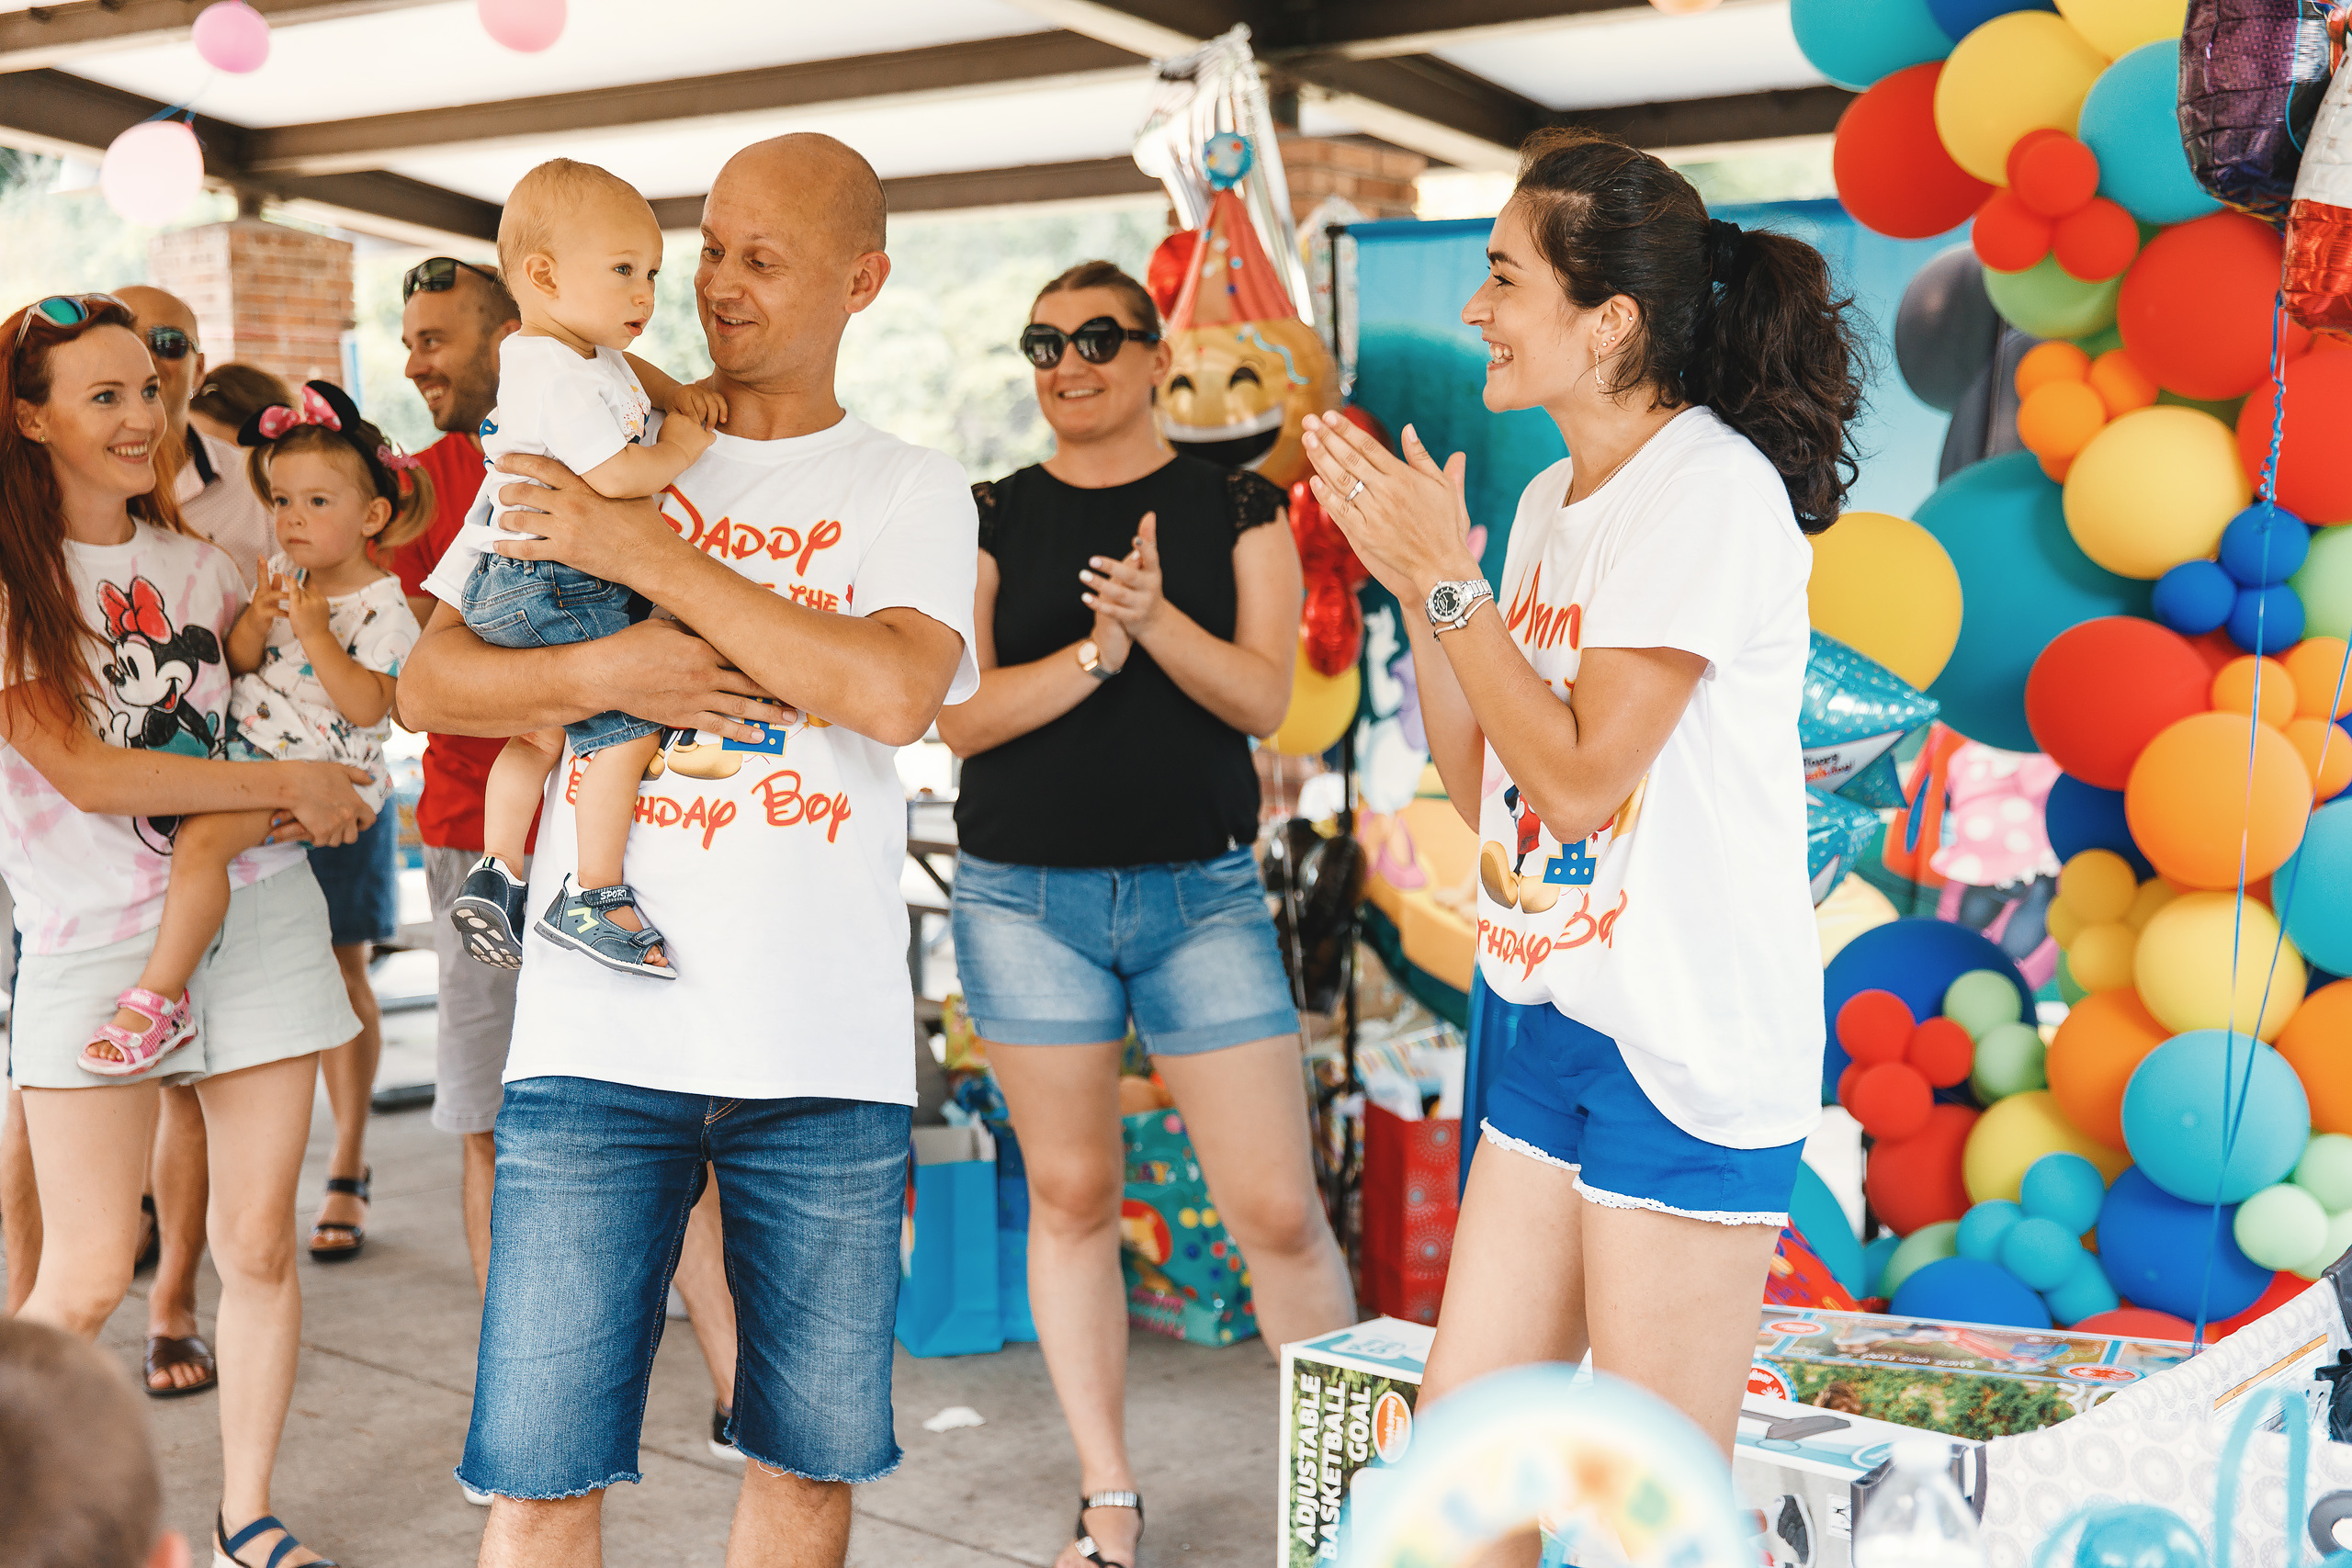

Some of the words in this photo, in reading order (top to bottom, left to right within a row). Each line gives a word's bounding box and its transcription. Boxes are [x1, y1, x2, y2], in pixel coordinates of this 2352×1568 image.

[659, 483, 842, 577] DADDY
[788, 582, 840, 614] THE
[752, 769, 852, 844] BOY
[600, 889, 628, 900] SPORT
[1296, 1373, 1321, 1548] ADJUSTABLE
[1347, 1386, 1372, 1463] GOAL
[1319, 1381, 1346, 1562] BASKETBALL
